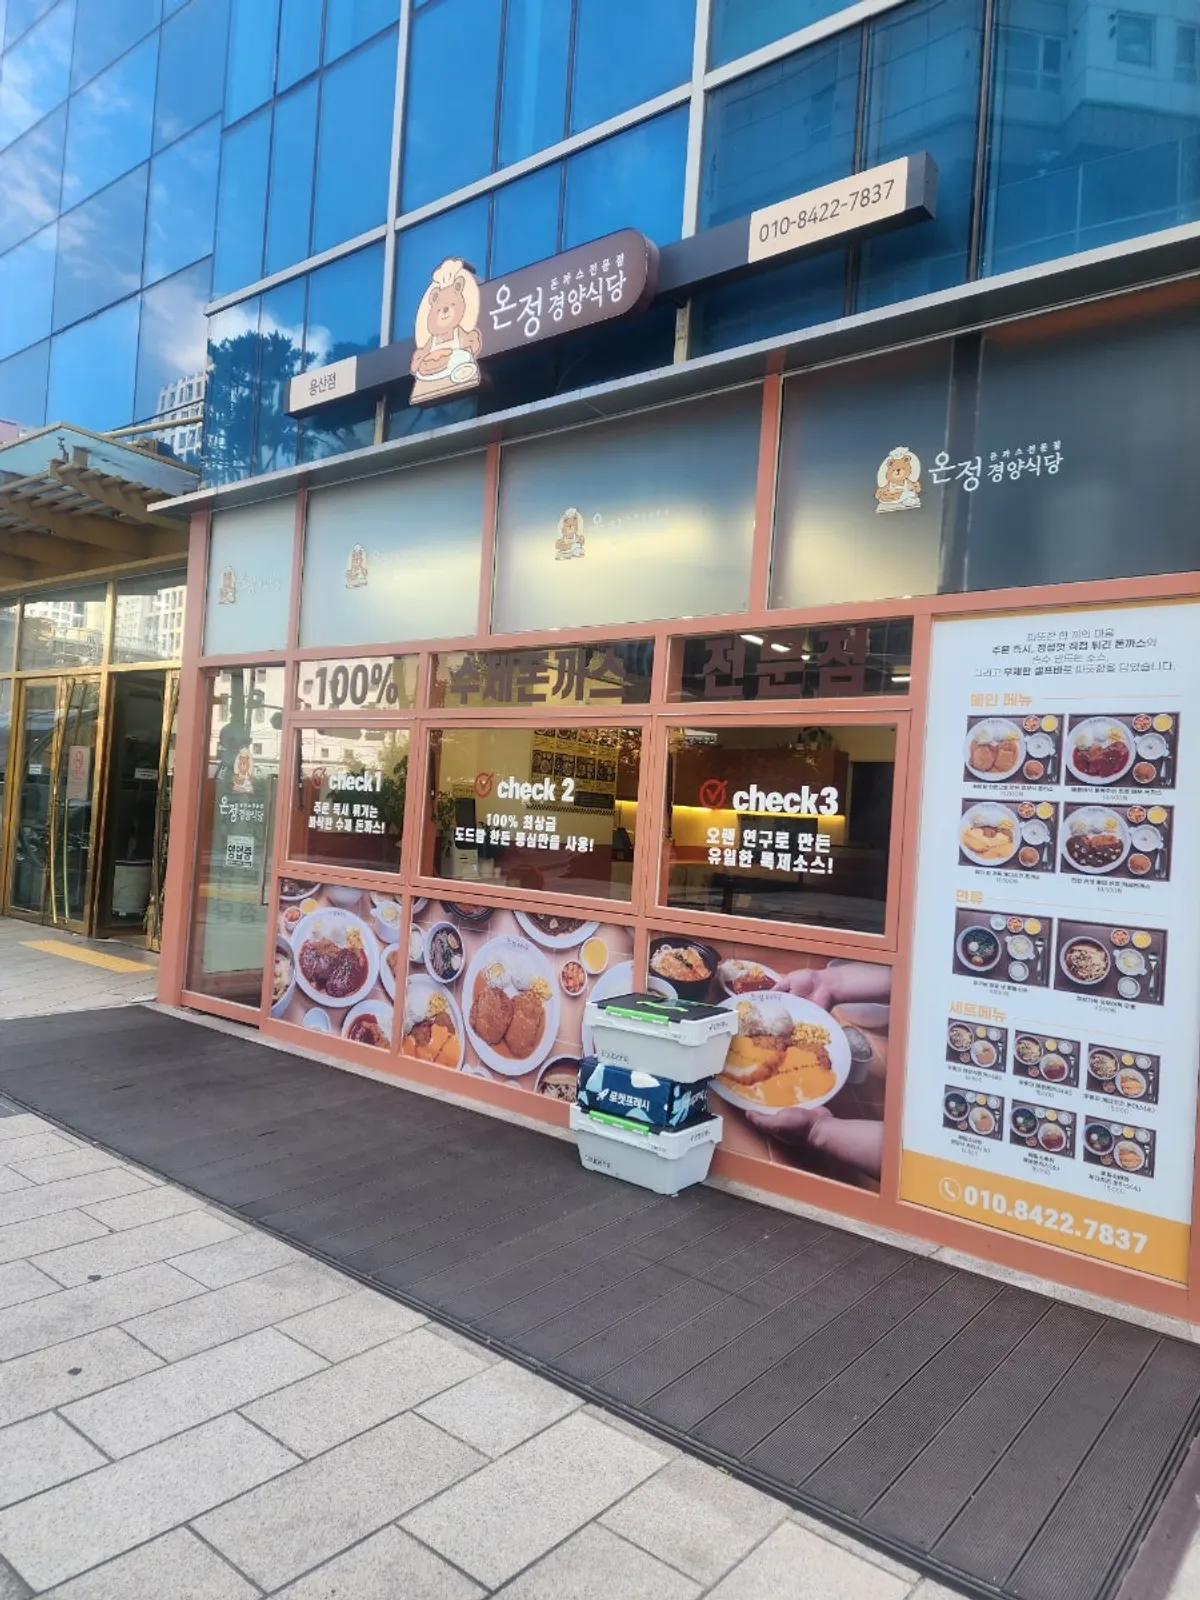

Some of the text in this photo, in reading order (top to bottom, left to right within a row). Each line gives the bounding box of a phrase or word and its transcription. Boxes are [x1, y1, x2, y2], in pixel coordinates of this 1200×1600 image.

[759, 179, 895, 243] 010-8422-7837
[489, 270, 627, 337] 온정 경양식당
[928, 451, 1064, 492] 온정 경양식당
[315, 663, 399, 706] 100%
[704, 627, 869, 697] 전문점
[497, 776, 575, 803] check 2
[732, 784, 839, 816] check3
[485, 813, 557, 832] 100% 최상급
[565, 835, 595, 853] 사용!
[743, 828, 790, 850] 연구로
[797, 832, 831, 853] 만든
[707, 846, 753, 868] 유일한
[964, 1185, 1148, 1254] 010.8422.7837
